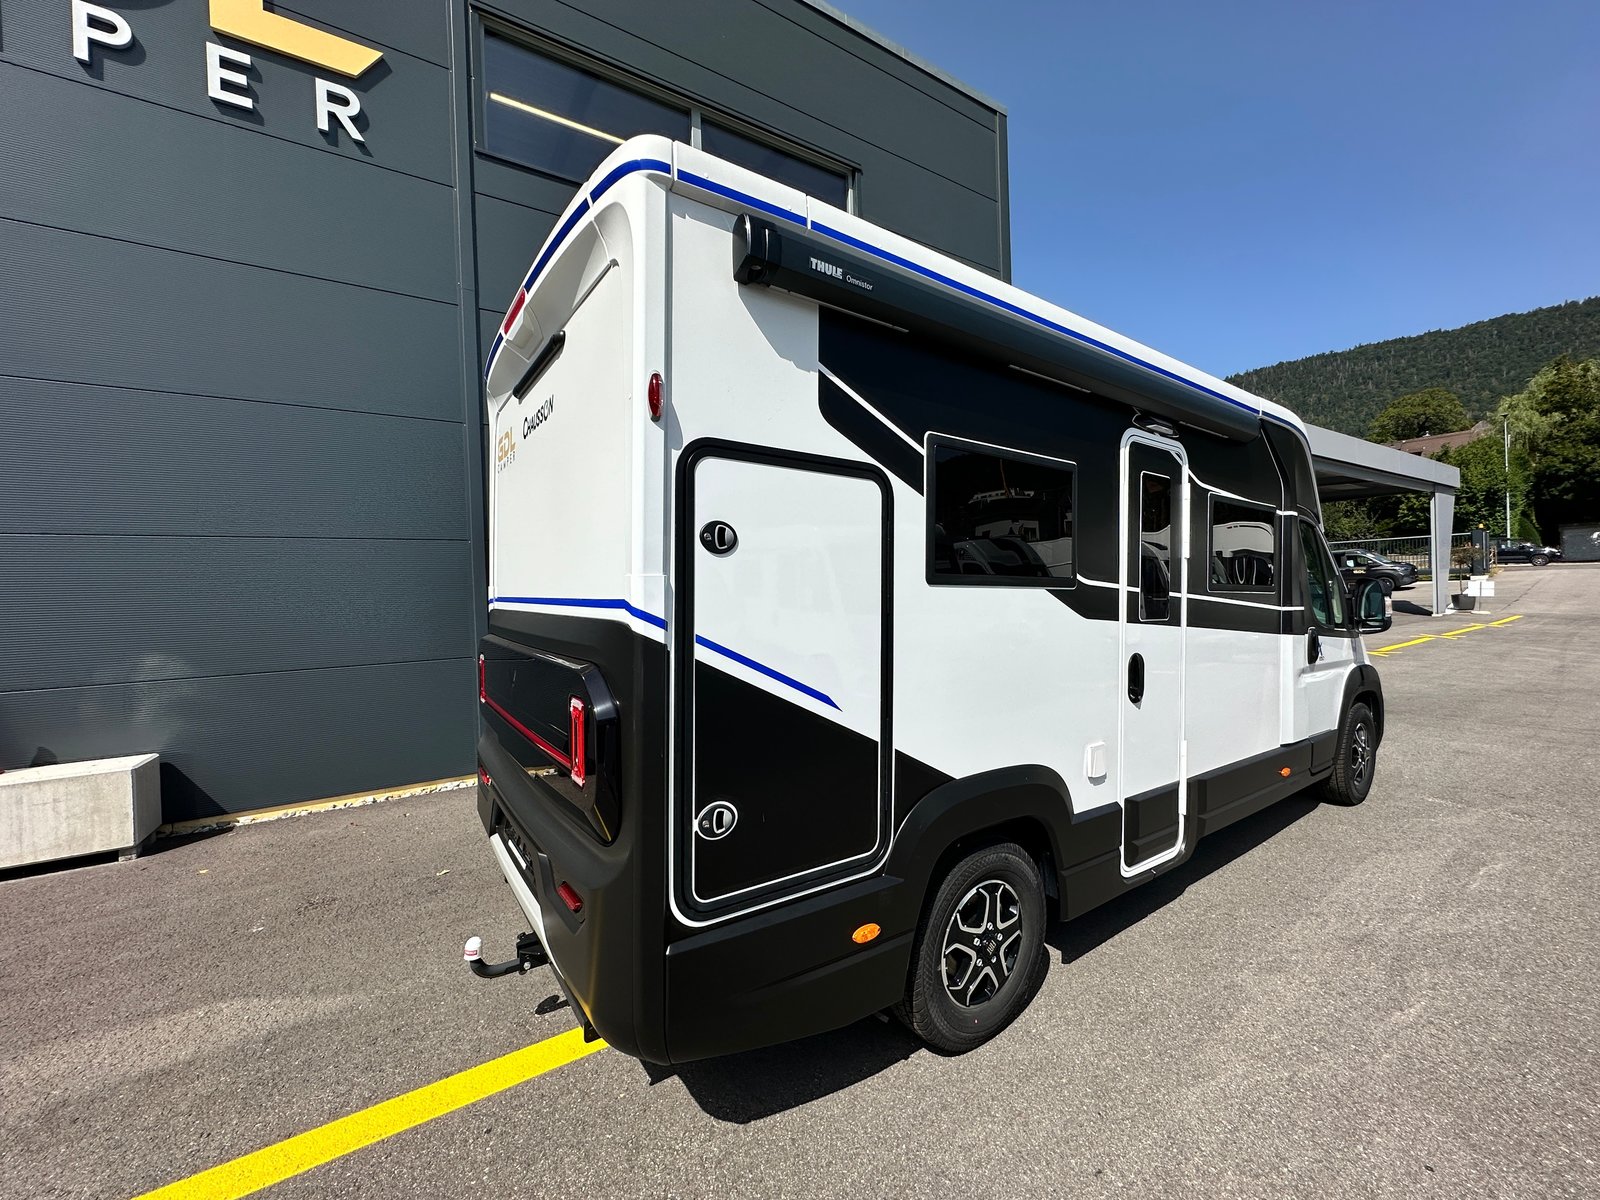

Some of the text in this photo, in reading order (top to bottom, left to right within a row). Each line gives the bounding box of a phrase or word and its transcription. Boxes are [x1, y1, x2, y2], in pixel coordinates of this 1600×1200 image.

[810, 256, 874, 291] THULE Omnistor
[522, 393, 555, 440] CHAUSSON
